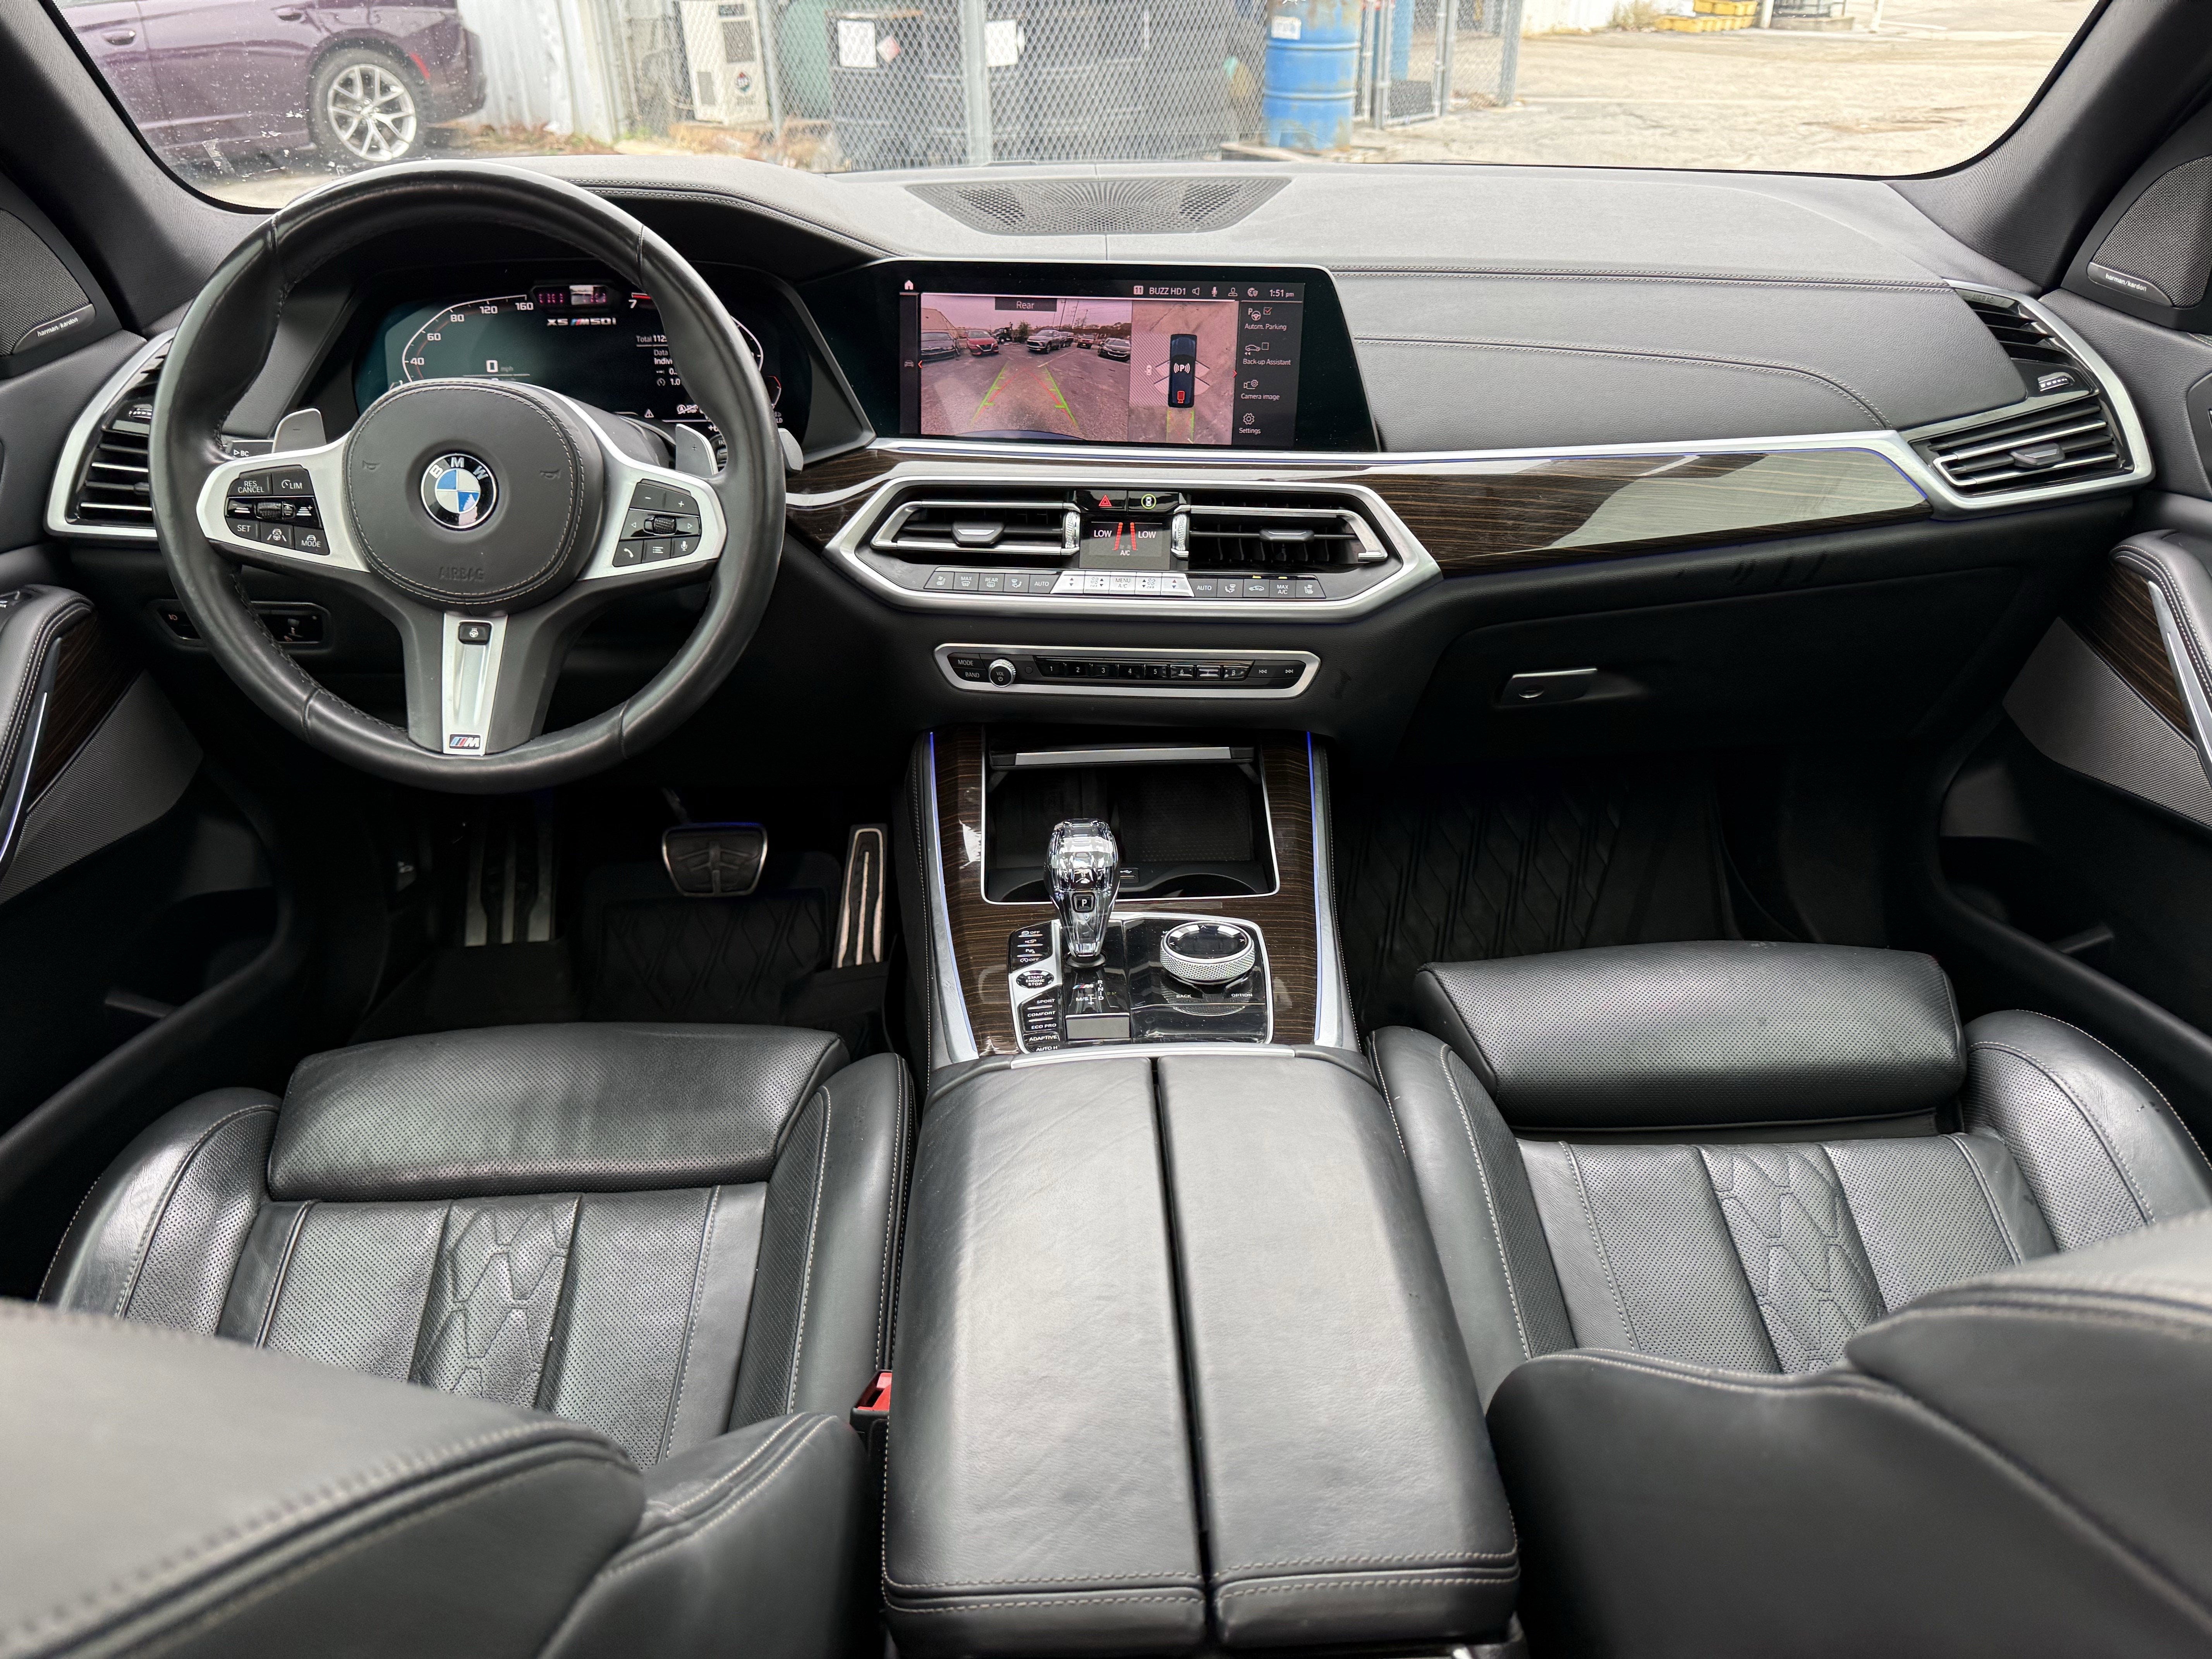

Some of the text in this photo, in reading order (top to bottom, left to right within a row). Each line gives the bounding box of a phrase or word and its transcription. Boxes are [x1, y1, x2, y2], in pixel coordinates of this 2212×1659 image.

[2105, 273, 2147, 292] harman/kardon
[515, 302, 534, 310] 160
[628, 299, 637, 309] 7
[1016, 301, 1034, 309] Rear
[479, 306, 498, 314] 120
[450, 314, 465, 322] 80
[37, 317, 78, 337] harman/kardon
[653, 334, 666, 342] 112
[486, 360, 498, 373] 0
[429, 457, 489, 481] BMW
[1094, 530, 1112, 538] LOW
[1082, 899, 1087, 907] P
